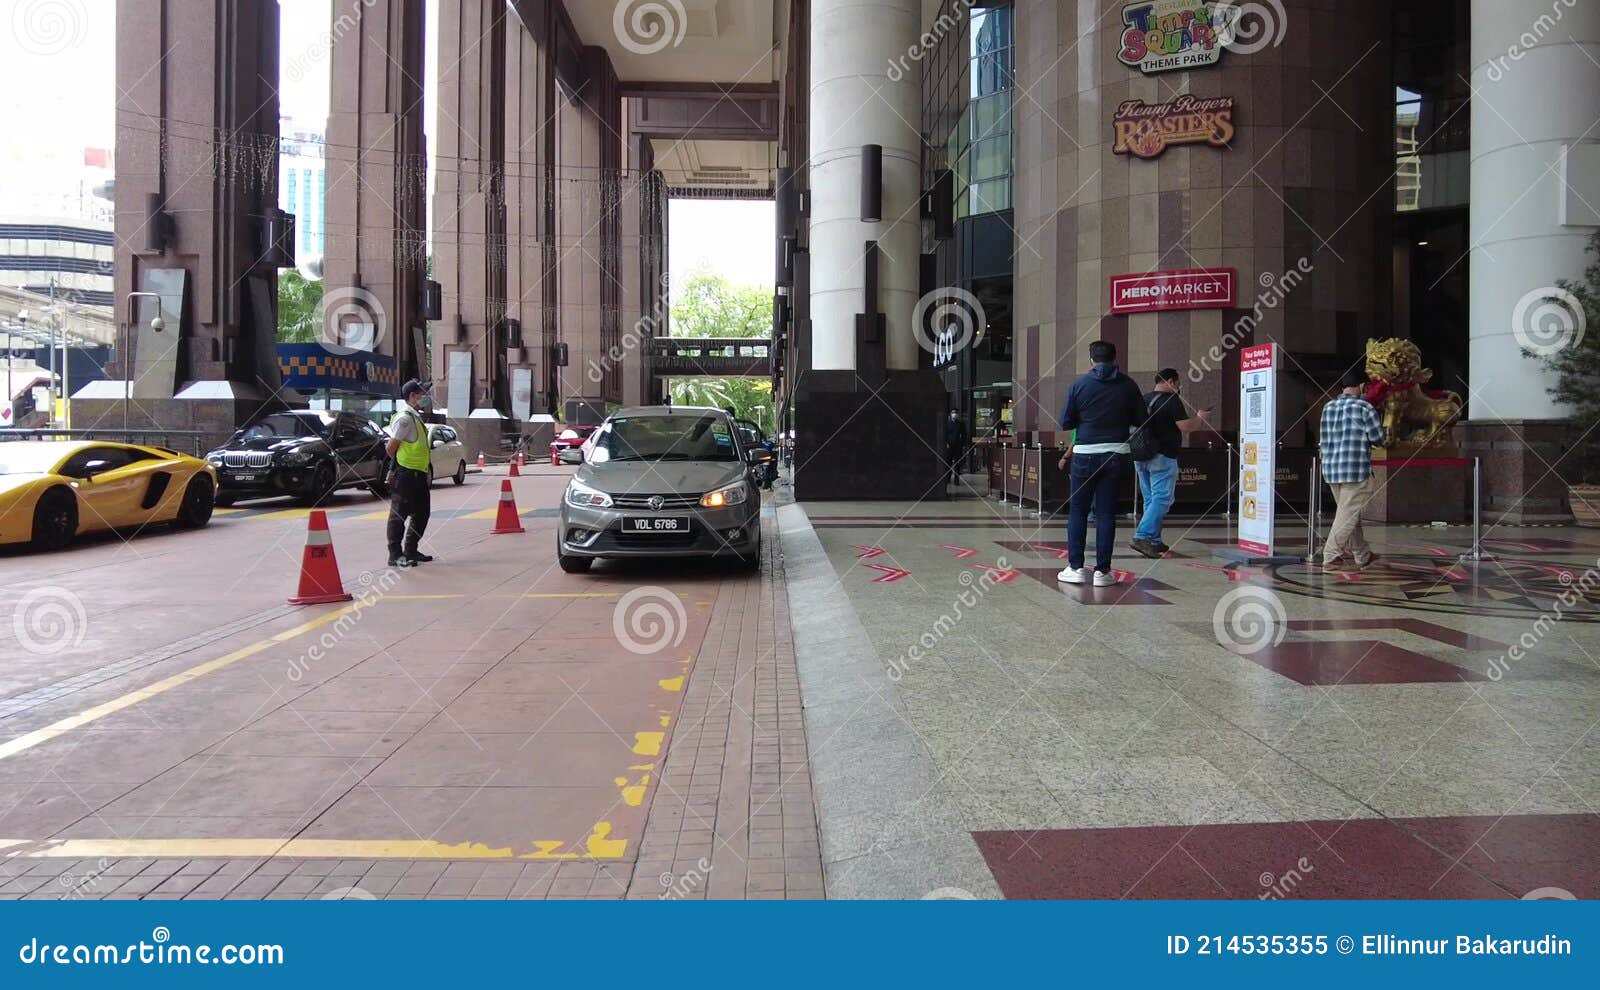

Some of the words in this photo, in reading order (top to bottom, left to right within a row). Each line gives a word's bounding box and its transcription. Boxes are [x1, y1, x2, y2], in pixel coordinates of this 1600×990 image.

[1144, 57, 1180, 70] THEME
[1183, 53, 1212, 65] PARK
[1115, 100, 1172, 119] Kenny
[1173, 96, 1233, 114] Rogers
[1114, 111, 1235, 156] ROASTERS
[1121, 282, 1222, 299] HEROMARKET
[634, 519, 652, 529] VDL
[654, 519, 677, 529] 6786
